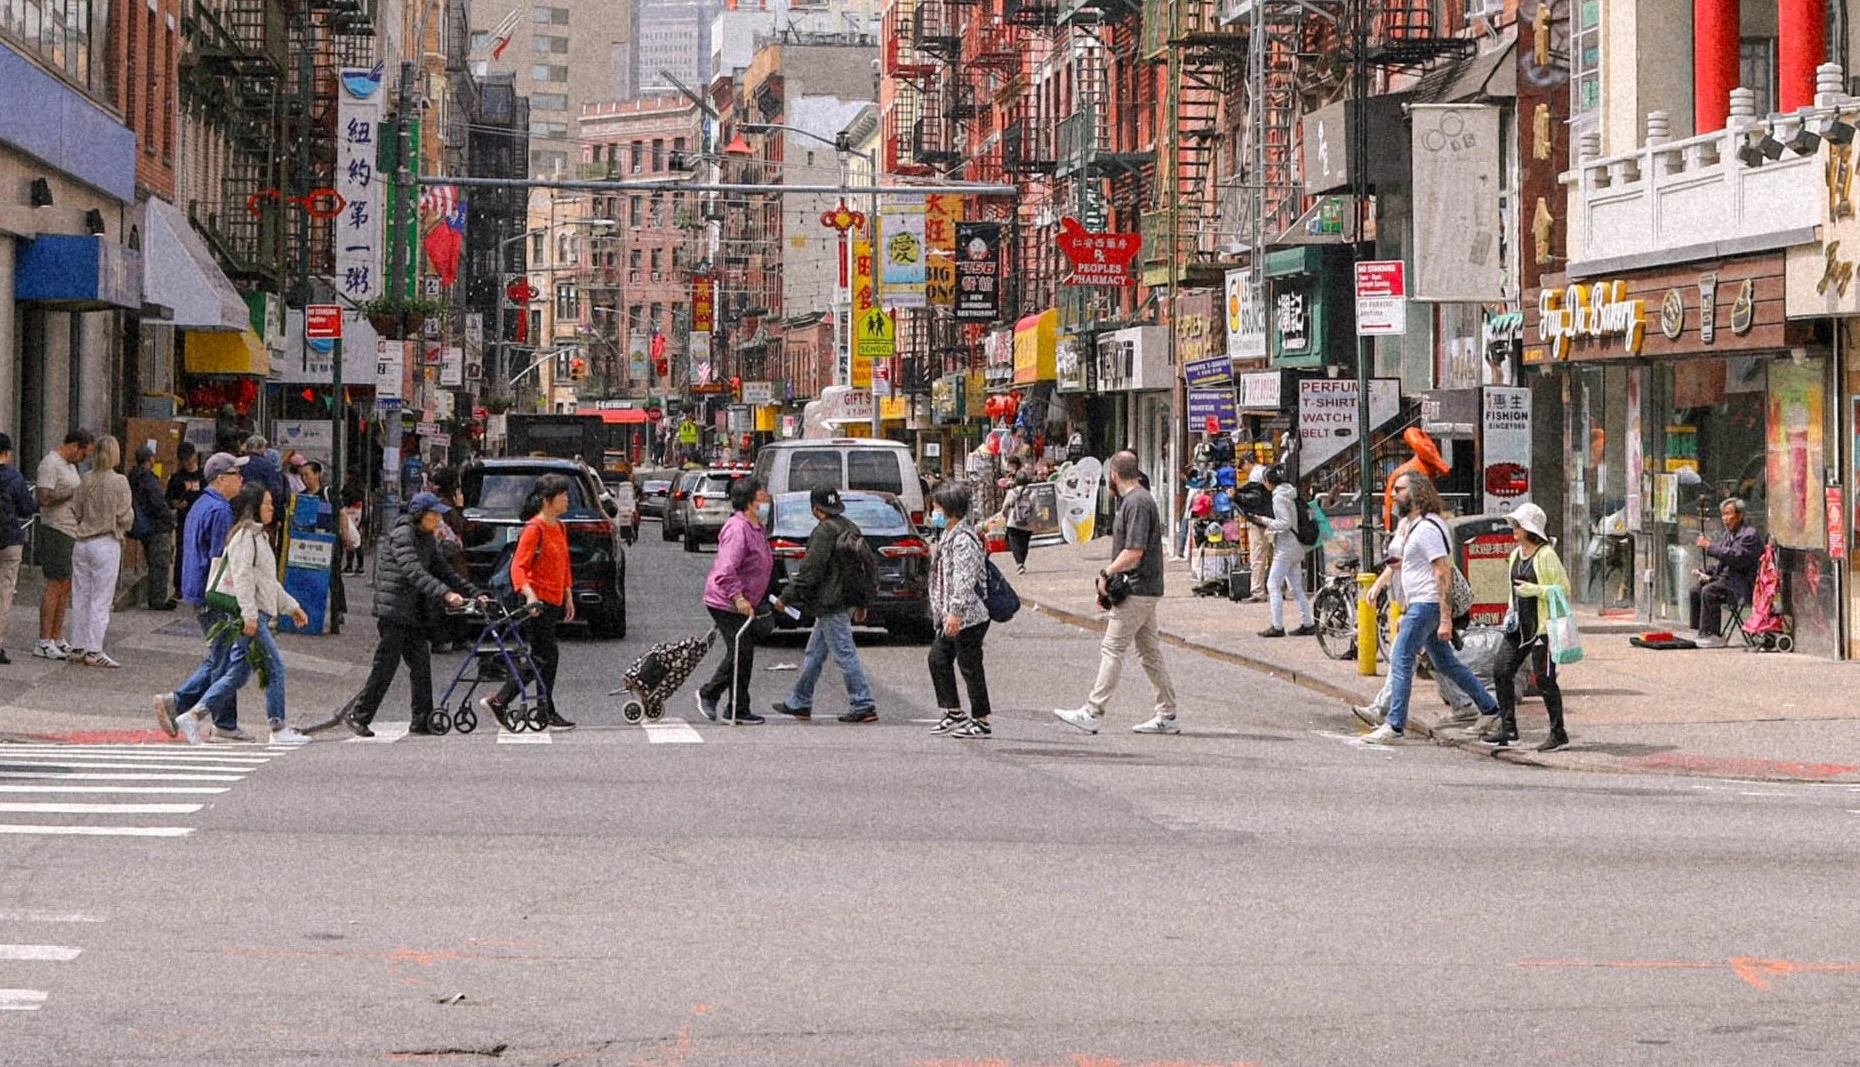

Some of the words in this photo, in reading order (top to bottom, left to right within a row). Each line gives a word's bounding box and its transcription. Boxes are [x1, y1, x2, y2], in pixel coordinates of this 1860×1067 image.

[346, 117, 371, 295] 紐約第一粥
[961, 261, 996, 274] 456
[1078, 264, 1121, 273] PEOPLES
[1359, 265, 1366, 273] NO
[1072, 275, 1126, 284] PHARMACY
[1540, 287, 1566, 359] Fay
[1590, 279, 1643, 353] Bakery
[860, 345, 890, 353] SCHOOL
[1301, 382, 1373, 393] PERFUME
[844, 394, 863, 405] GIFT
[1303, 398, 1357, 408] T-SHIRT
[1302, 413, 1352, 423] WATCH
[1486, 411, 1528, 421] FISHION
[1302, 428, 1330, 438] BELT
[1473, 613, 1500, 626] SHOW
